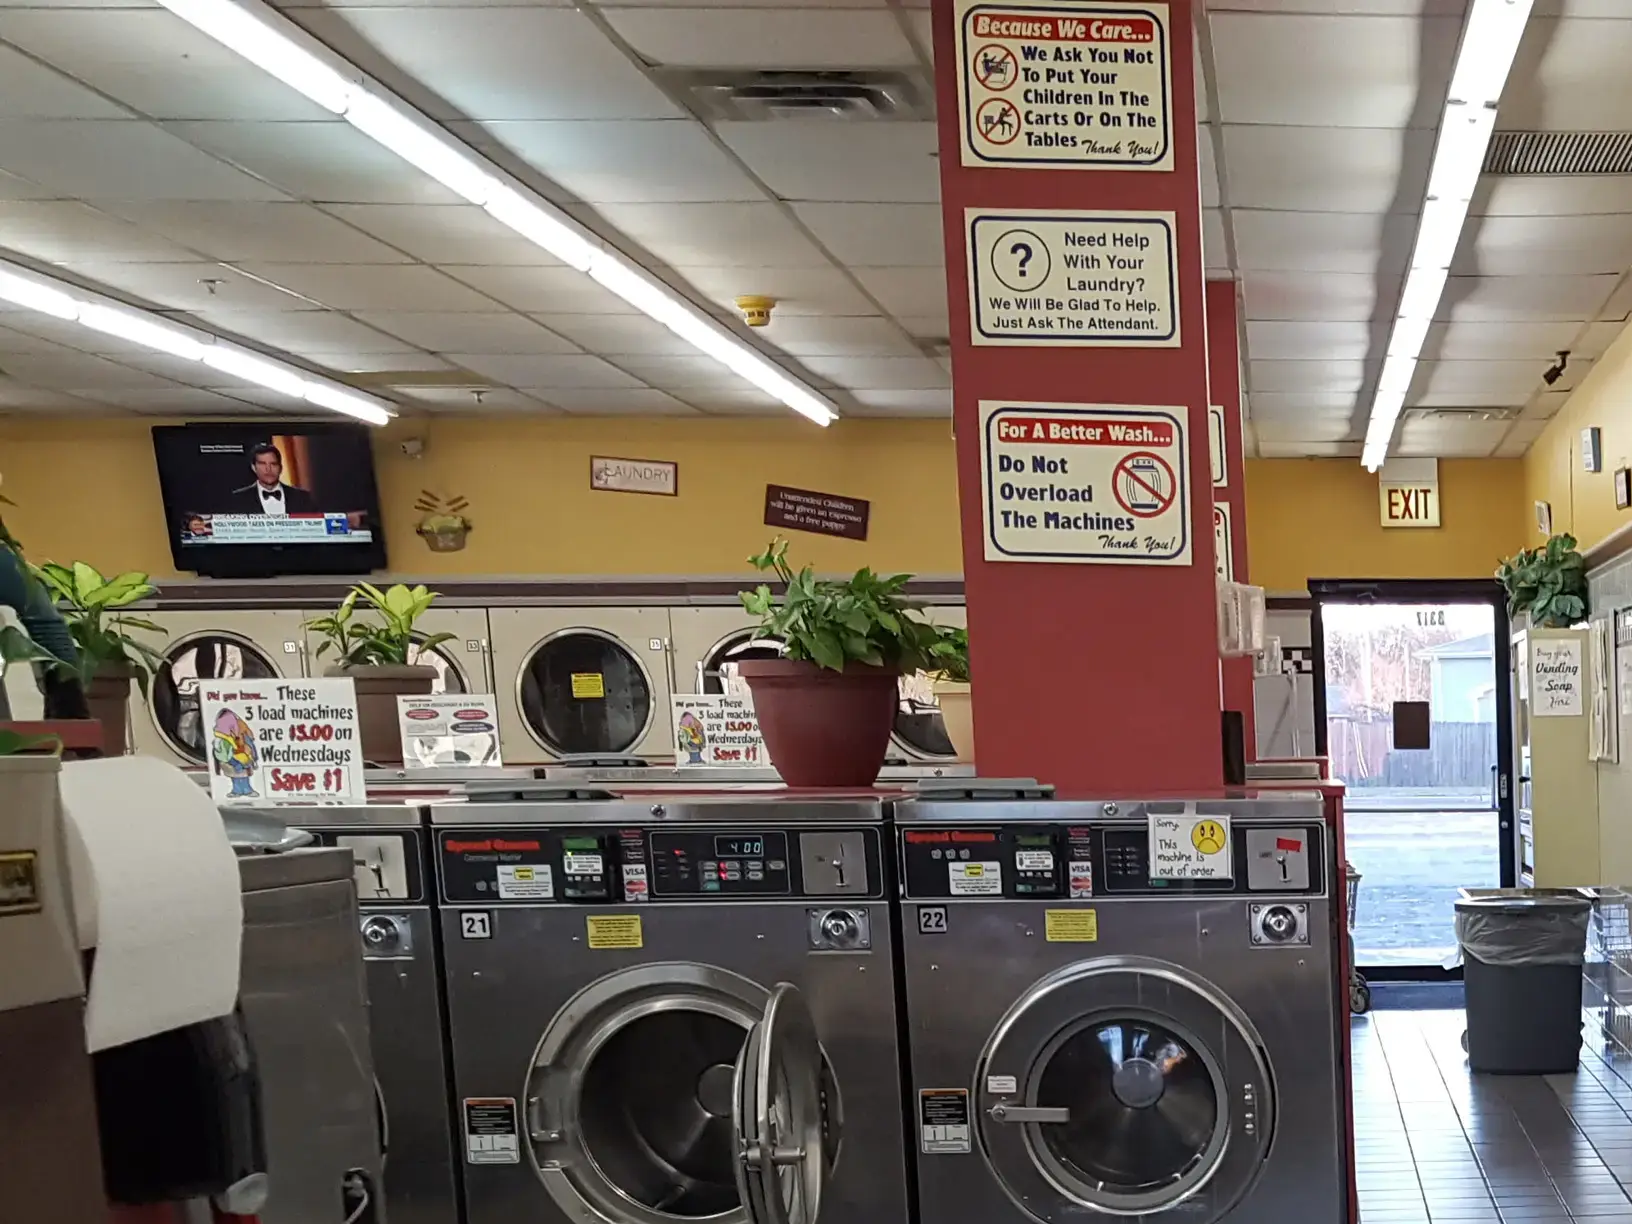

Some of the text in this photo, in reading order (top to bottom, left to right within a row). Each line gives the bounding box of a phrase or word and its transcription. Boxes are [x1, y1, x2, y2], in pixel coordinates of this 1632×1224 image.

[977, 16, 1151, 42] Because We Care...
[1021, 46, 1153, 65] We Ask You Not
[1022, 68, 1117, 85] To Put Your
[1023, 89, 1149, 107] Children In The
[1025, 111, 1156, 128] Carts Or On The
[1025, 131, 1078, 148] Tables
[1081, 139, 1160, 157] Thank You!
[1065, 232, 1150, 251] Need Help
[1064, 254, 1144, 271] With Your
[1067, 277, 1145, 295] Laundry?
[990, 297, 1160, 314] We Will Be Glad To Help.
[993, 316, 1158, 331] Just Ask The Attendant.
[1000, 422, 1171, 443] For A Better Wash...
[999, 455, 1068, 474] Do Not
[1000, 483, 1093, 502] Overload
[770, 501, 862, 523] will be given an espresso
[823, 499, 854, 512] Children
[1388, 489, 1431, 520] EXIT
[784, 513, 798, 522] and
[806, 516, 821, 526] free
[1001, 510, 1135, 531] The Machines
[1098, 535, 1175, 553] Thank You!
[1536, 662, 1579, 676] Vending
[277, 685, 316, 700] These
[1545, 680, 1572, 692] Soap
[719, 699, 743, 708] These
[245, 704, 353, 721] 3 load machines
[707, 710, 724, 719] load
[259, 728, 284, 741] are
[335, 728, 352, 741] on
[707, 723, 722, 732] are
[261, 745, 351, 766] Wednesdays
[713, 747, 741, 761] Save
[271, 768, 343, 792] Save $1
[1159, 839, 1177, 850] This
[1158, 852, 1205, 862] machine is
[625, 868, 645, 876] VISA
[1159, 864, 1215, 876] out of order
[466, 917, 487, 934] 21
[923, 912, 944, 929] 22
